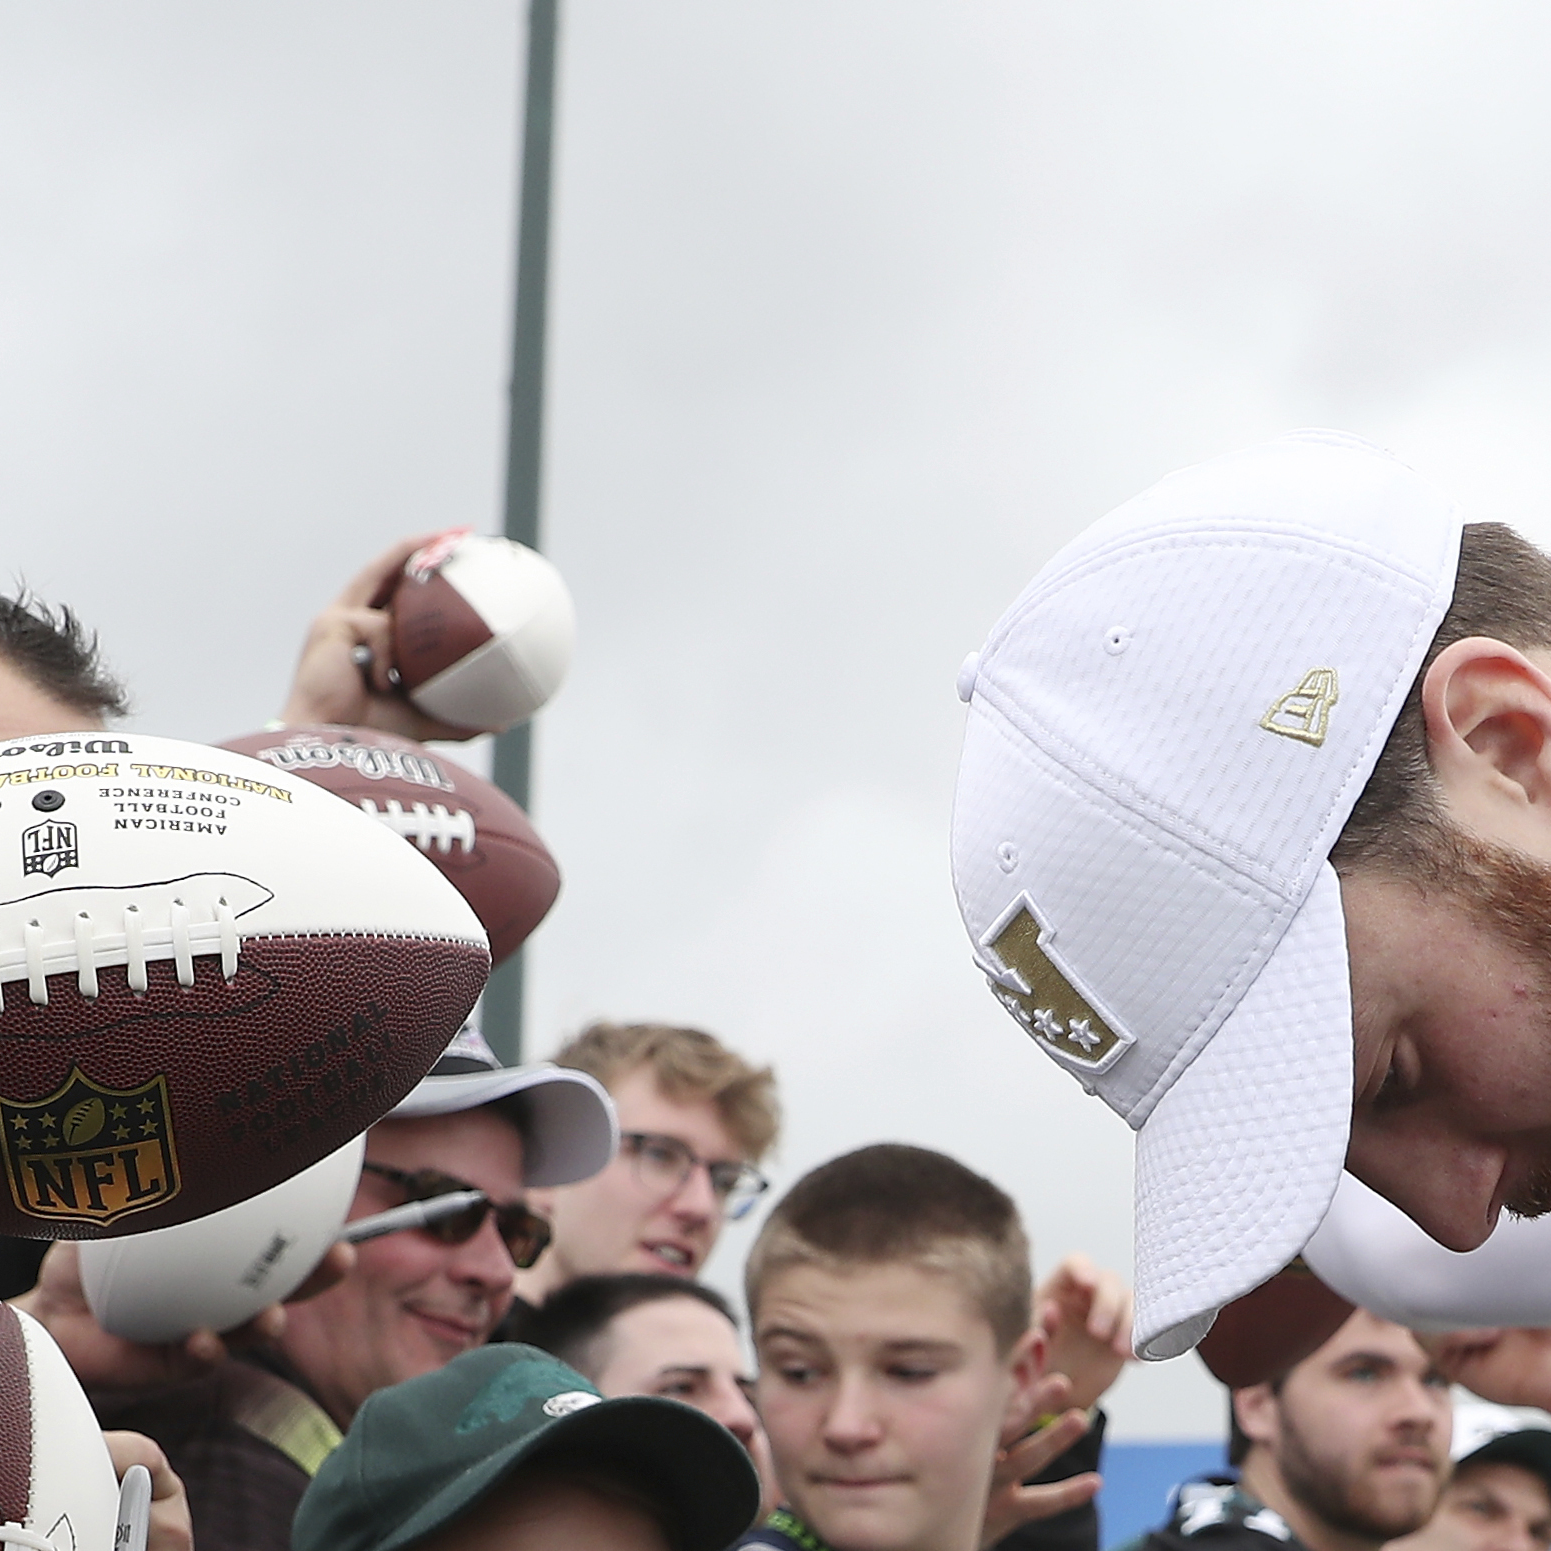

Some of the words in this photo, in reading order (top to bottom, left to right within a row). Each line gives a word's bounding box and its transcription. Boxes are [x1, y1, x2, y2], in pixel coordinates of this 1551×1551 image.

[130, 763, 293, 803] NATIONAL
[257, 744, 456, 792] Wilson
[99, 788, 241, 807] CONFERENCE
[115, 803, 226, 819] FOOTBALL
[27, 826, 72, 853] NFL
[114, 819, 227, 835] AMERICAN
[219, 1002, 389, 1115] NATIONAL
[25, 1149, 162, 1211] NFL
